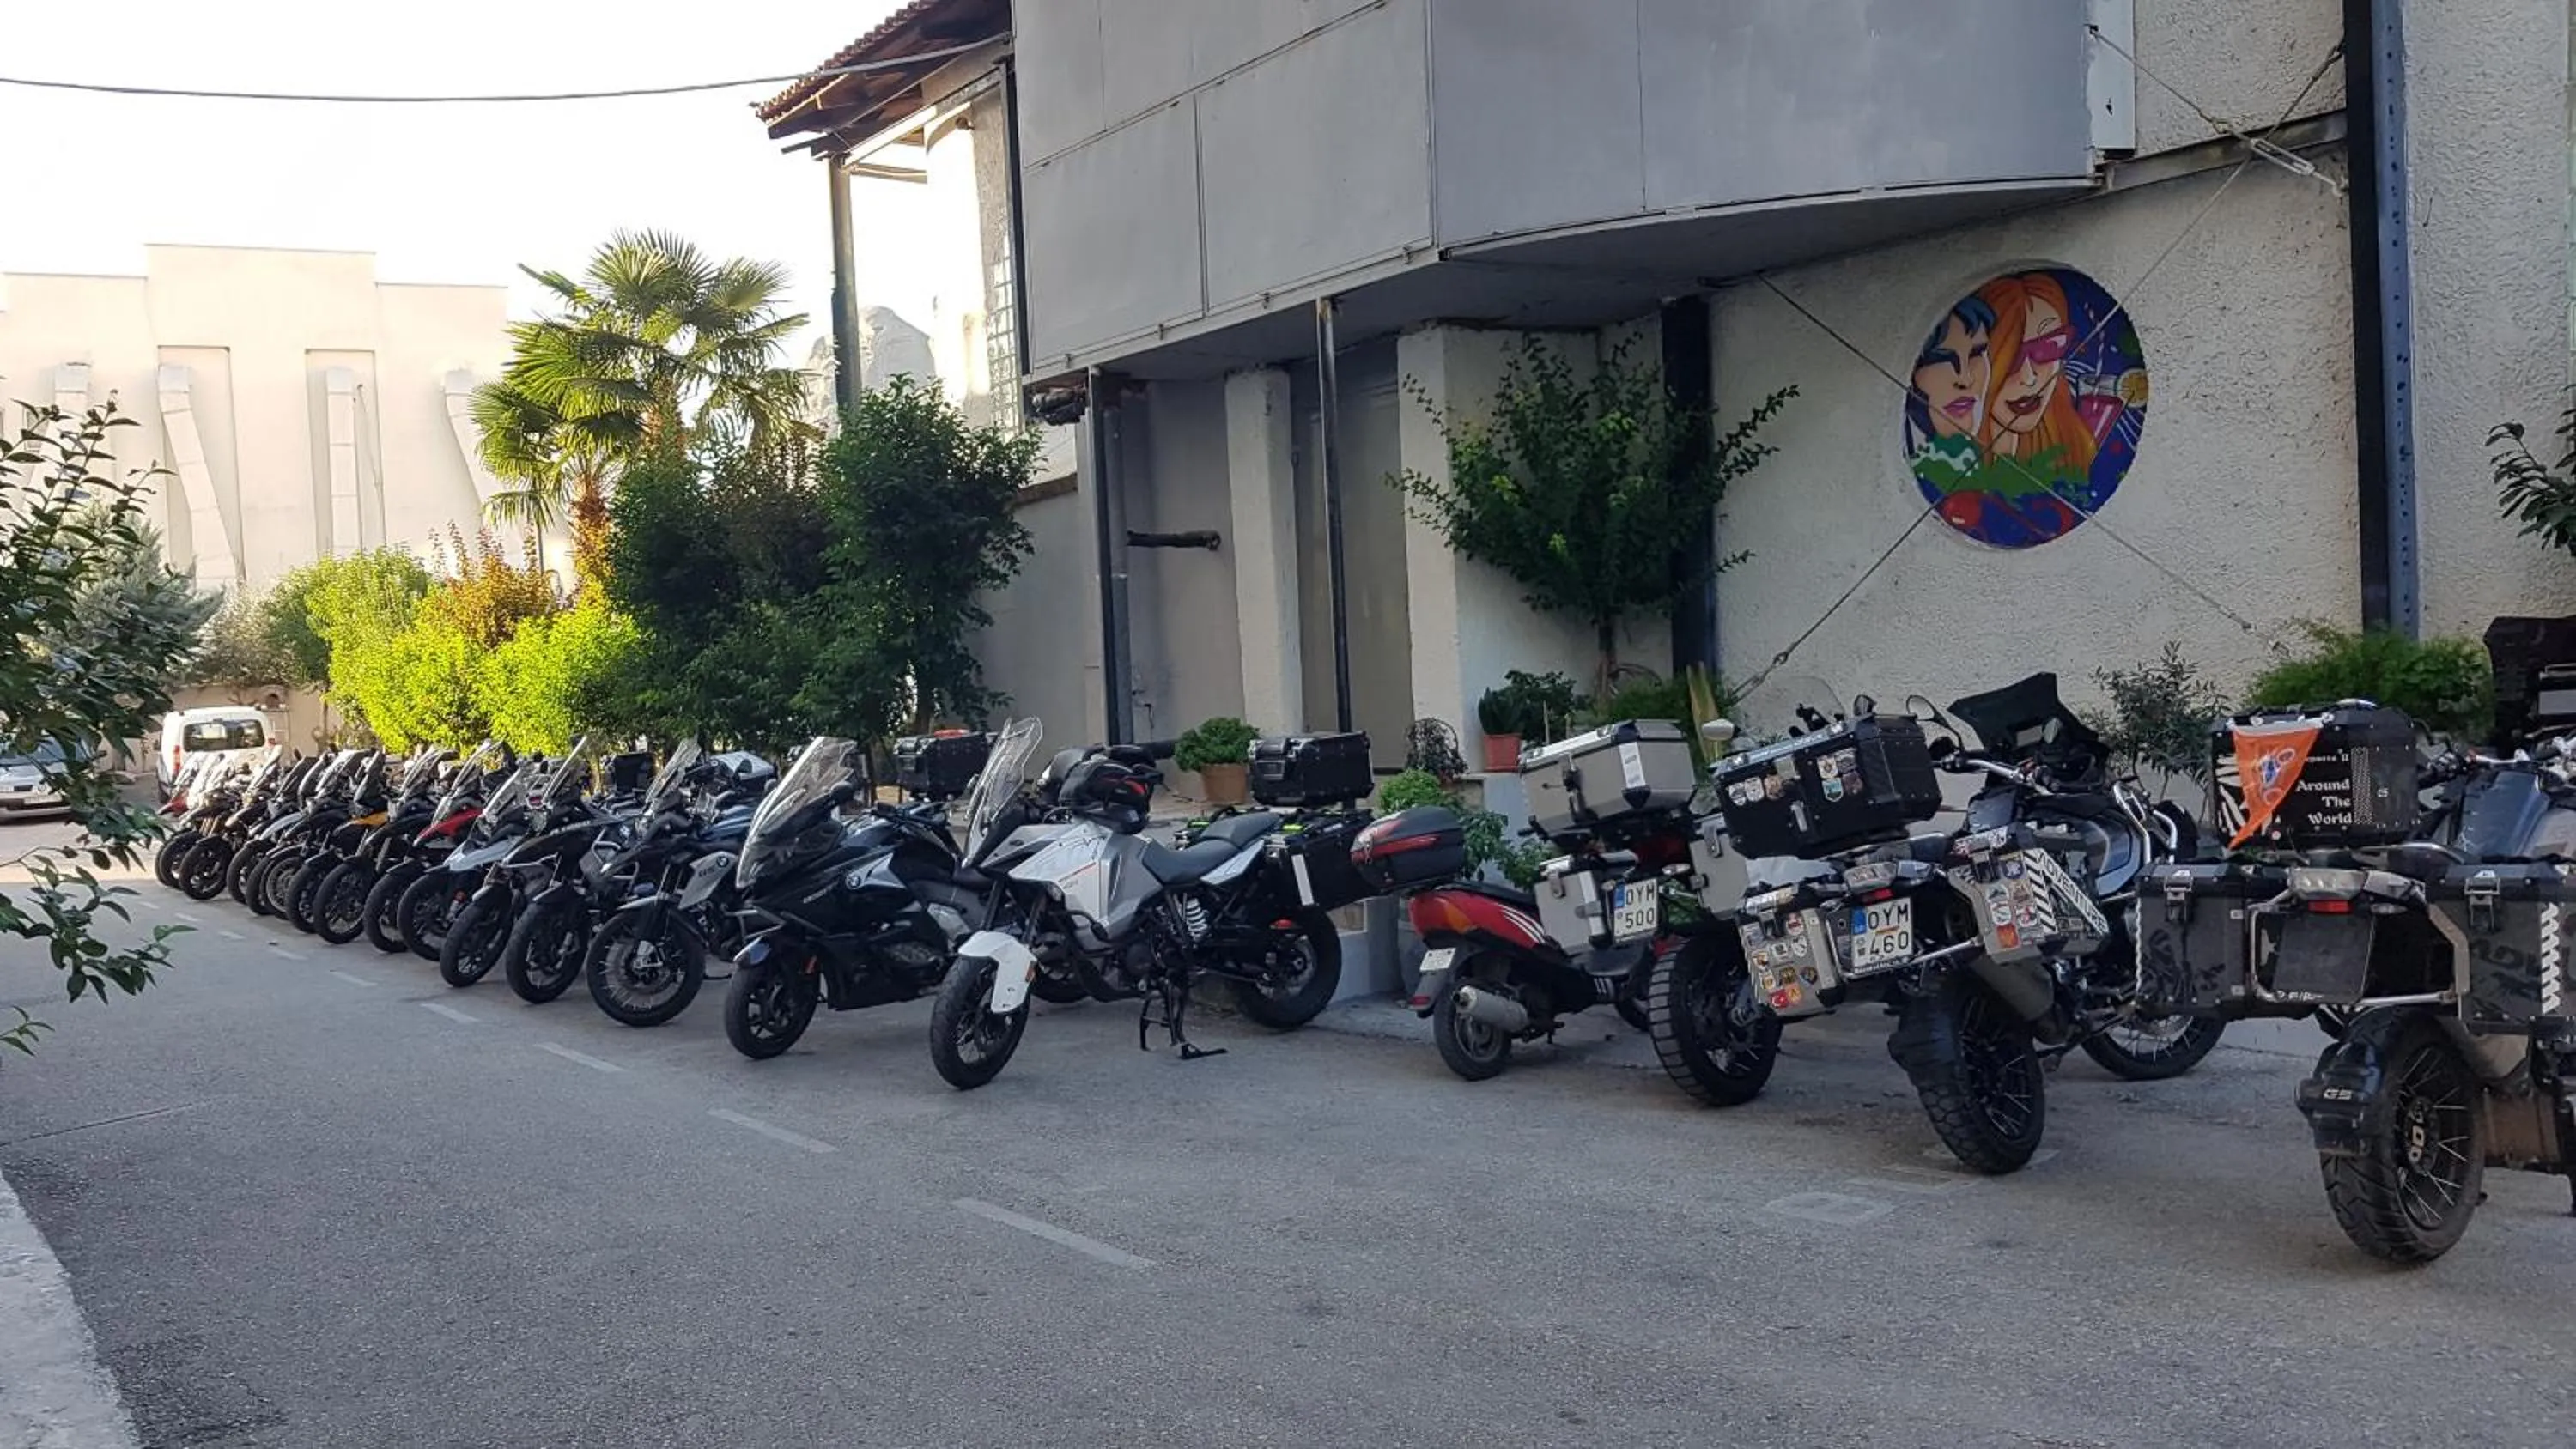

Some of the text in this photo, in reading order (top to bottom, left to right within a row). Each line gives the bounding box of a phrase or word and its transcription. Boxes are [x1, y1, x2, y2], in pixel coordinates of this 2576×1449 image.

[2296, 778, 2350, 791] Around
[2322, 796, 2351, 807] The
[2308, 812, 2353, 824] World
[1625, 908, 1655, 929] 500
[1868, 903, 1909, 930] OYM
[1869, 931, 1909, 955] 460
[2323, 1088, 2352, 1100] GS
